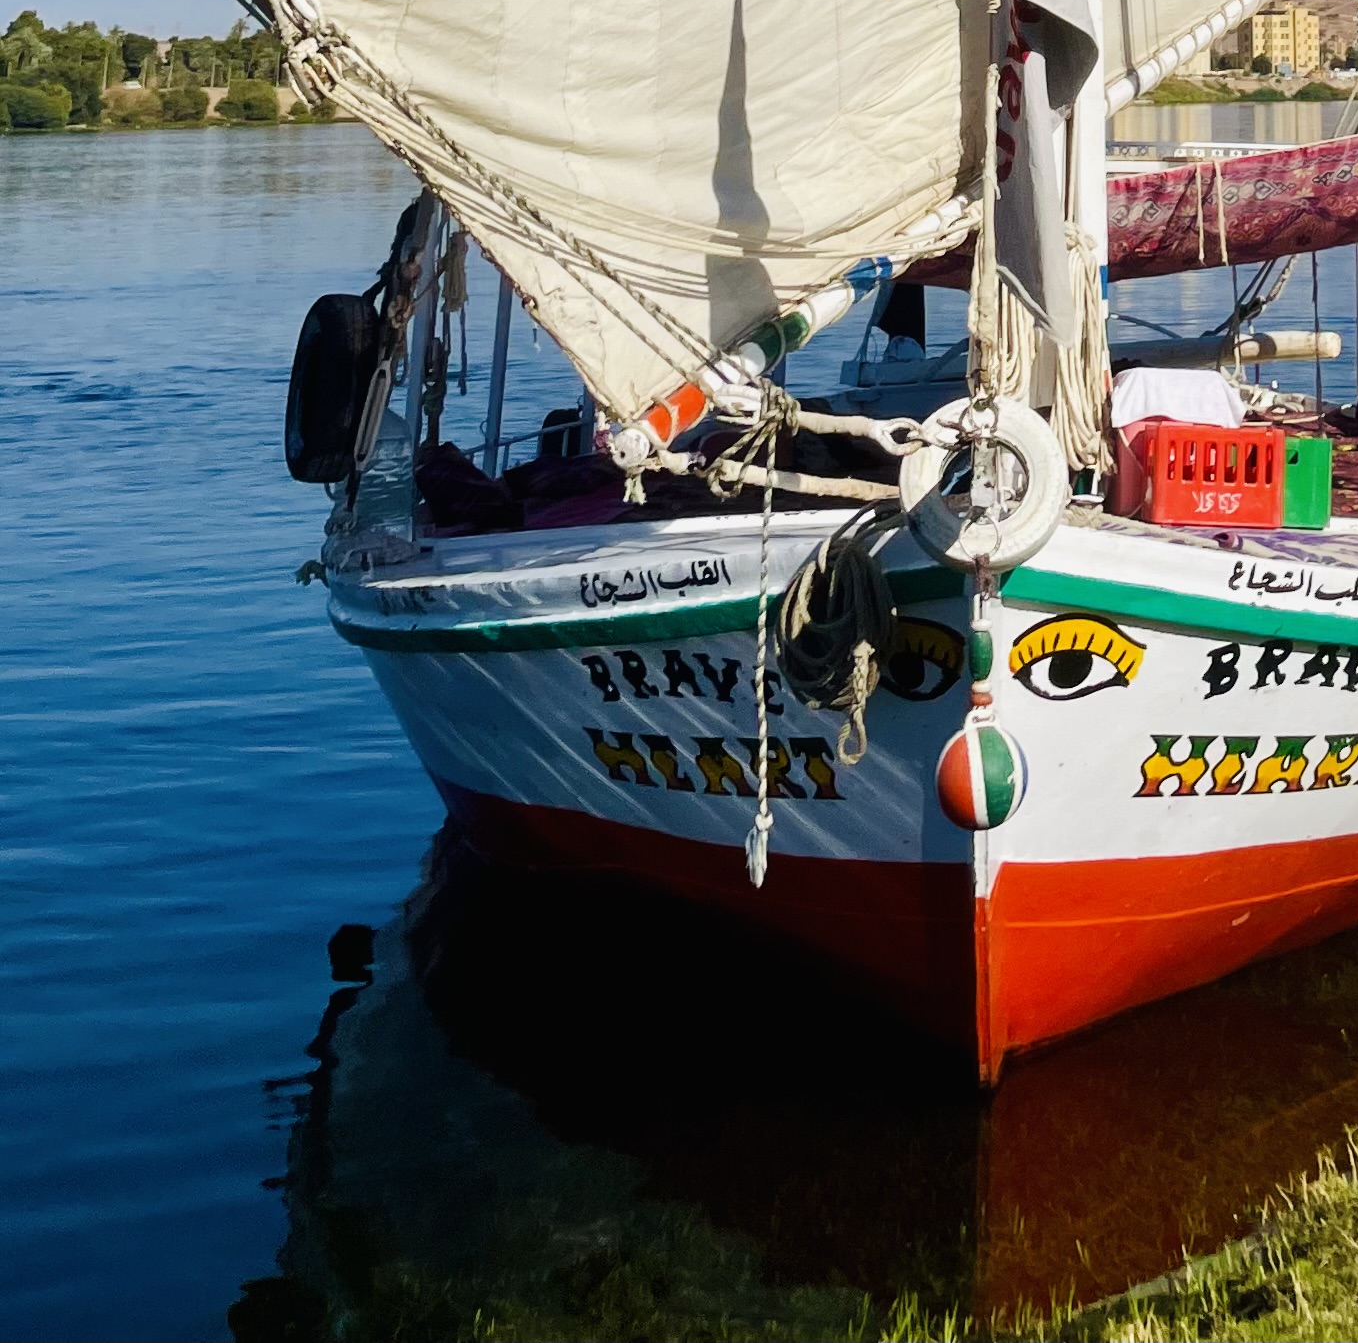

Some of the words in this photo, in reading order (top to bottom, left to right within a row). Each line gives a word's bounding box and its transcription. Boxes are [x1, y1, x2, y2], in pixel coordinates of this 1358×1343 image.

[579, 569, 659, 608] الشجاع
[657, 558, 732, 597] القلب
[1227, 560, 1314, 597] الشجاع
[580, 649, 785, 716] BRAVE
[582, 725, 847, 800] HEART
